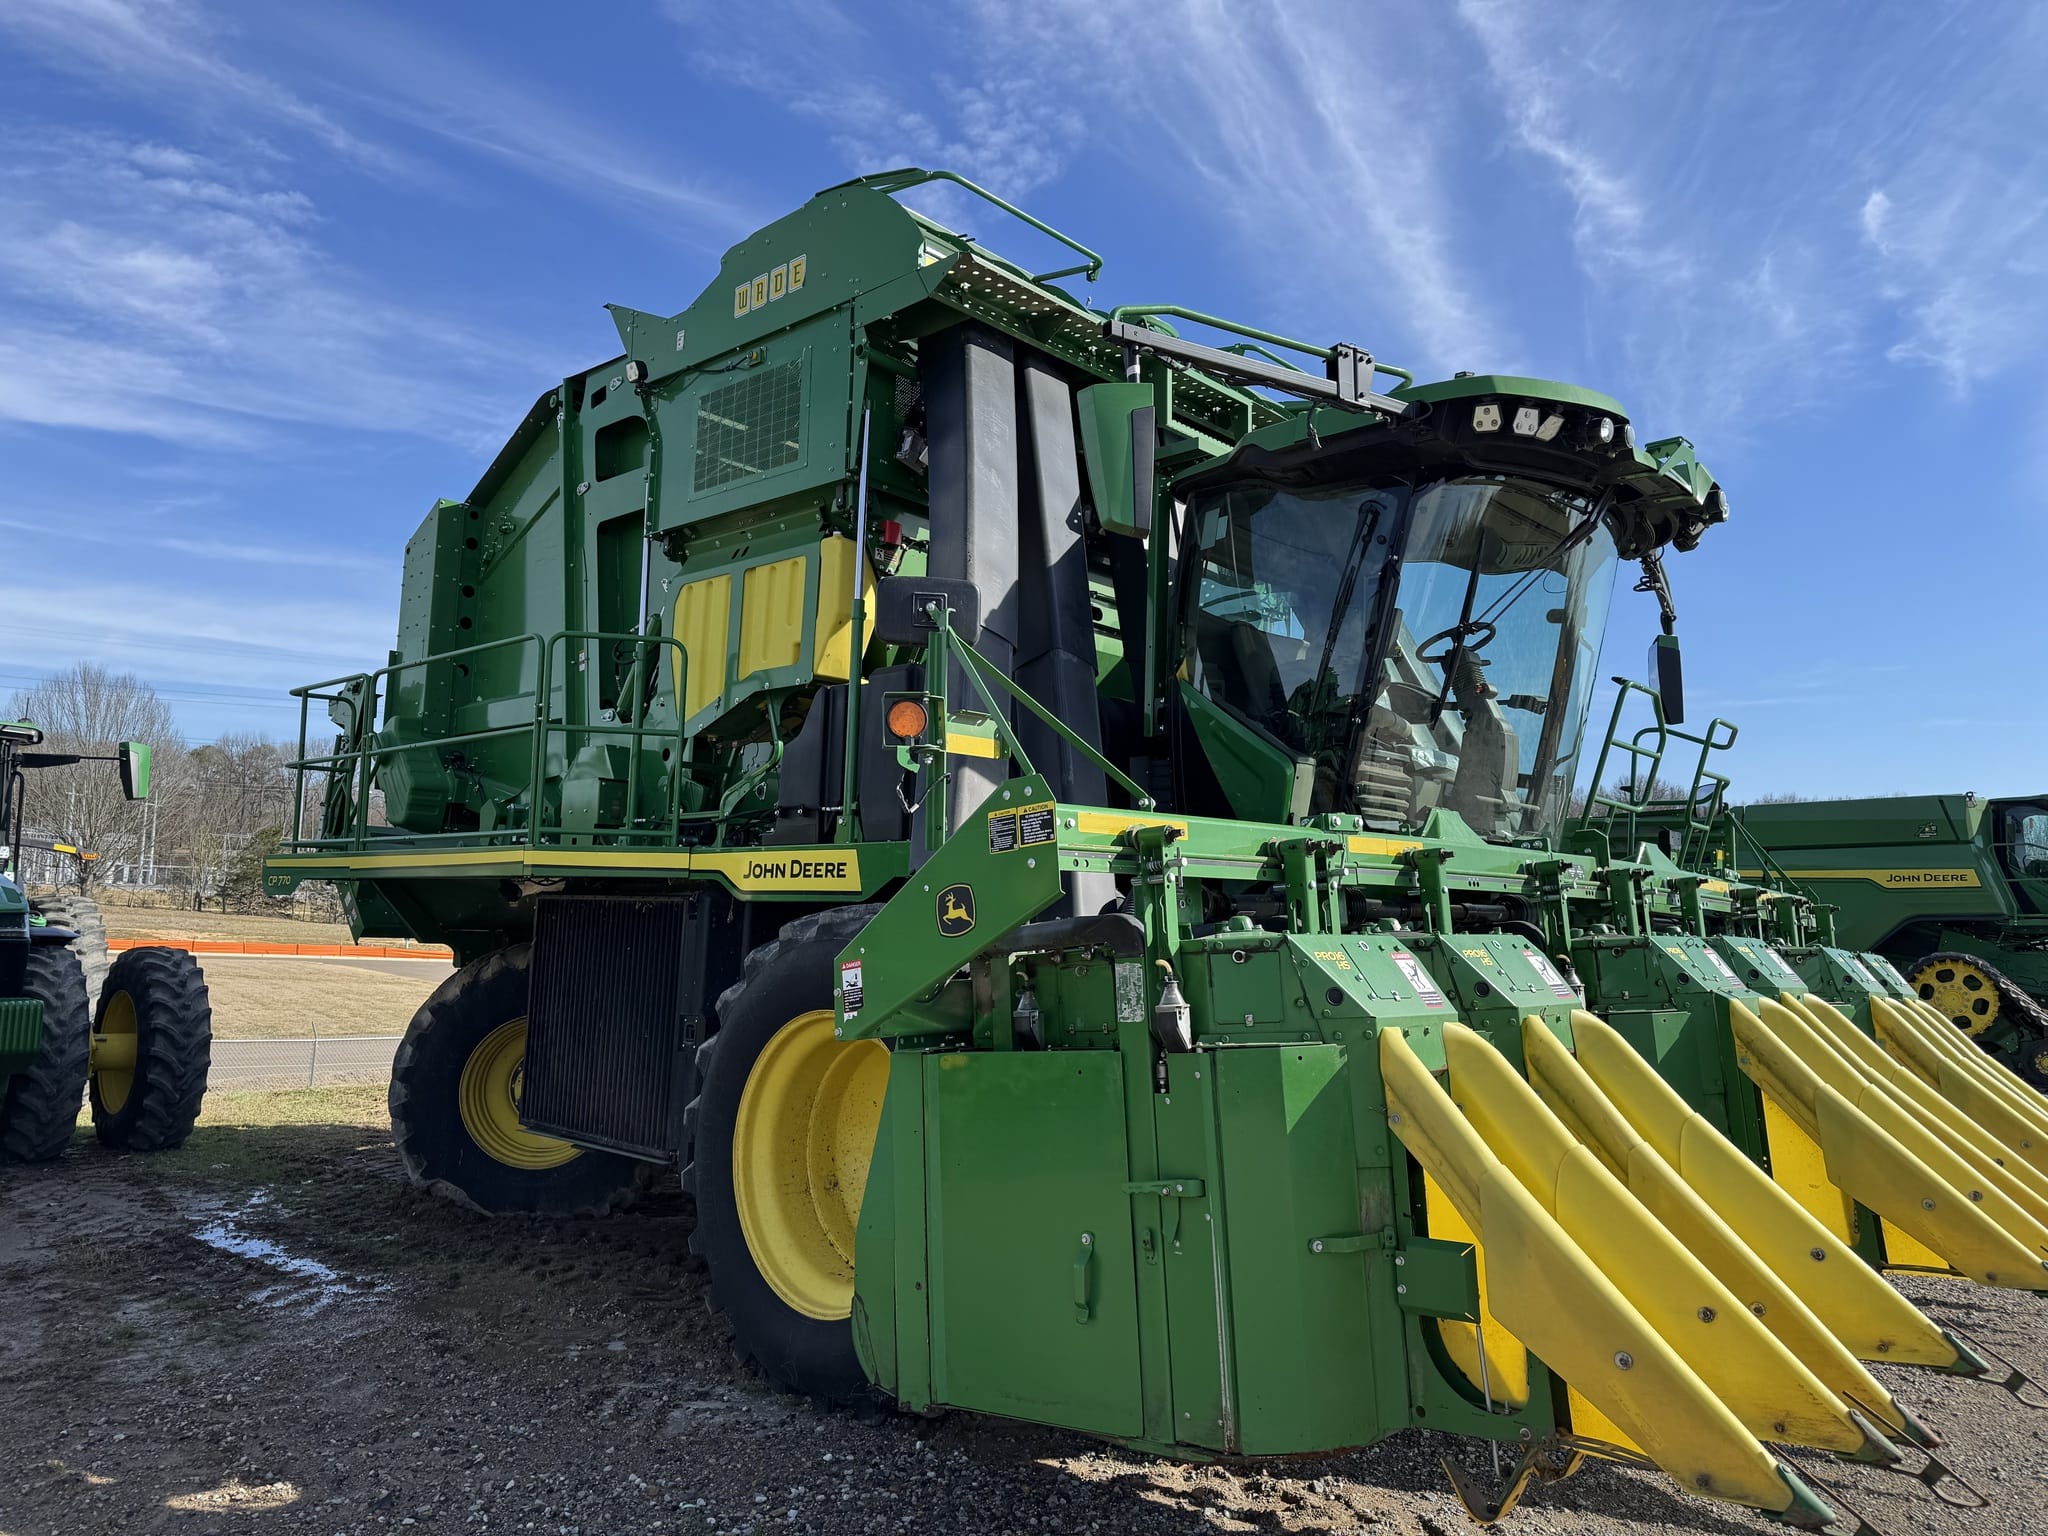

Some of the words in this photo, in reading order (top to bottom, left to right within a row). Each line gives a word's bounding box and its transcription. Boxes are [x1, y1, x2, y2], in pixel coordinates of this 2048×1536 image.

[737, 258, 804, 313] WADE
[743, 861, 786, 879] JOHN
[790, 860, 847, 878] DEERE
[268, 876, 277, 886] CP
[278, 875, 291, 886] 770
[1886, 874, 1920, 882] JOHN
[1923, 873, 1968, 882] DEERE
[1314, 951, 1346, 961] PRO16
